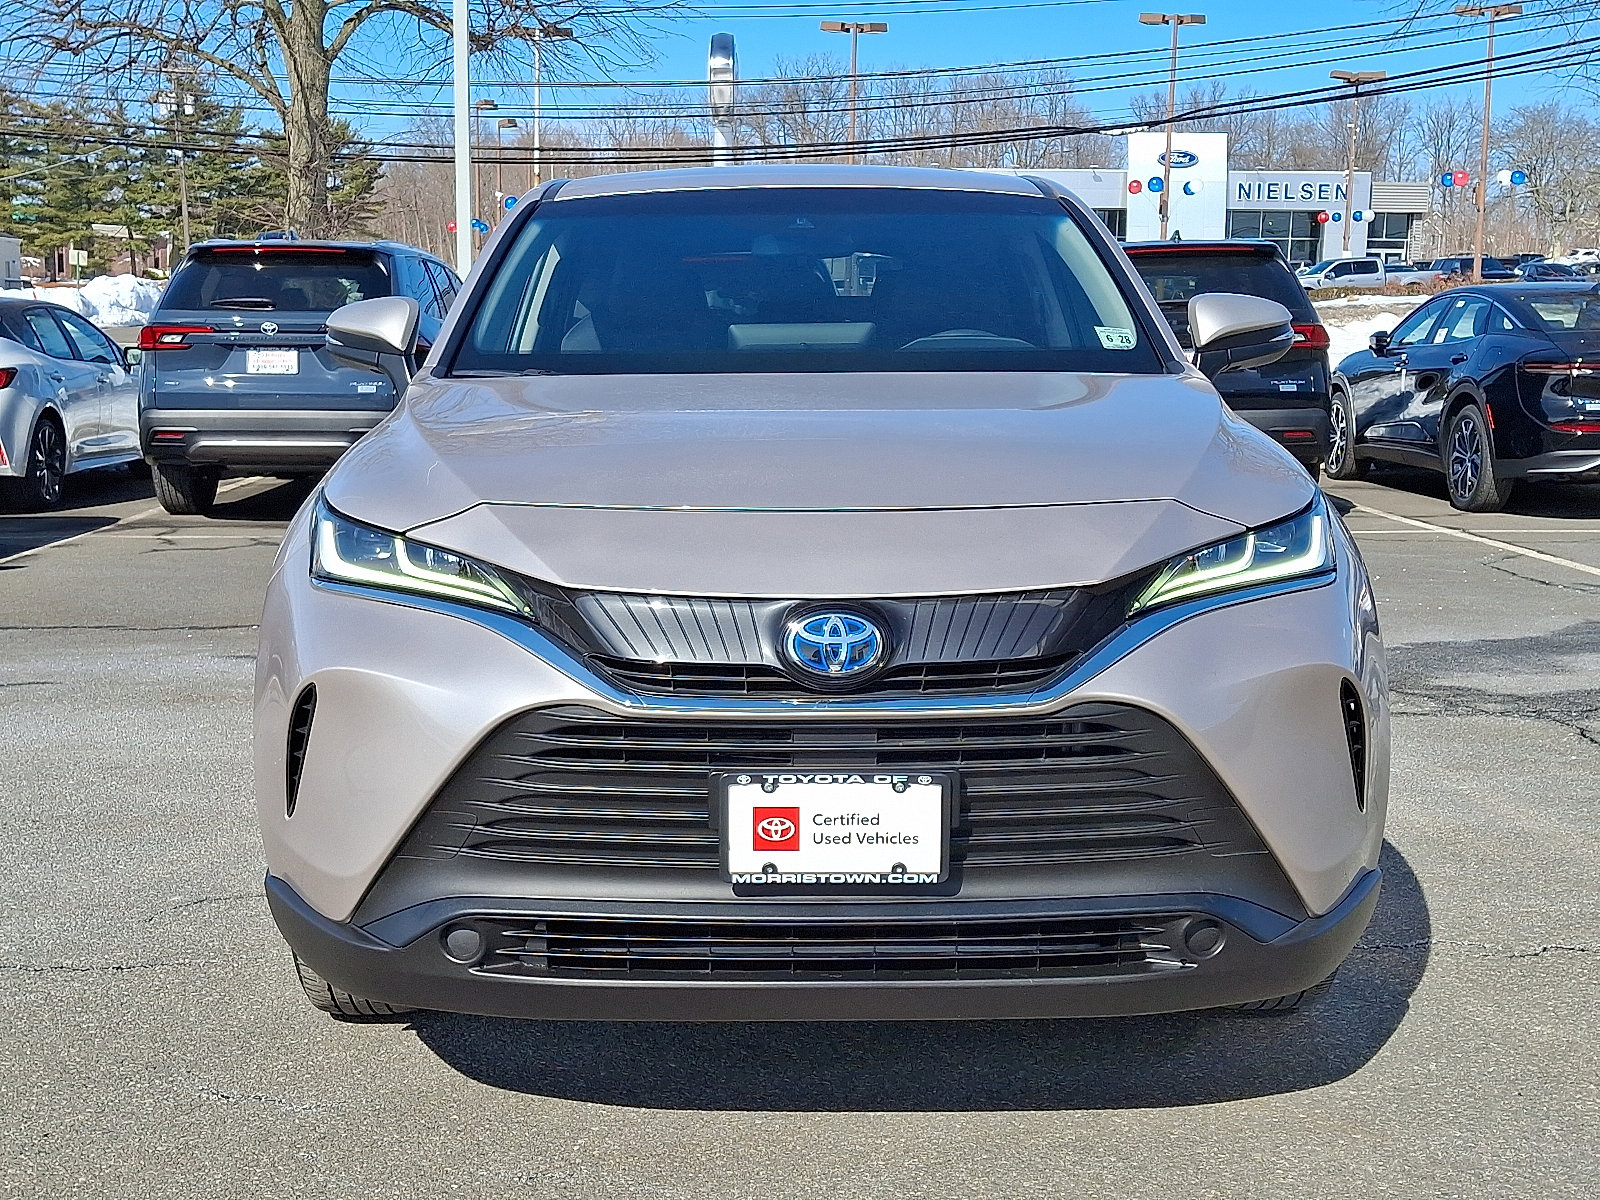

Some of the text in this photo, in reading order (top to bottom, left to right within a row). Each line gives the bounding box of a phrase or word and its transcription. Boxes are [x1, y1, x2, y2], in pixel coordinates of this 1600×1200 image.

[1237, 182, 1346, 200] NIELSEN
[1106, 334, 1132, 344] 6 28
[762, 774, 909, 784] TOYOTA OF
[812, 812, 880, 826] Certified
[812, 832, 920, 845] Used Vehicles
[731, 873, 939, 884] MORRISTOWN.COM
